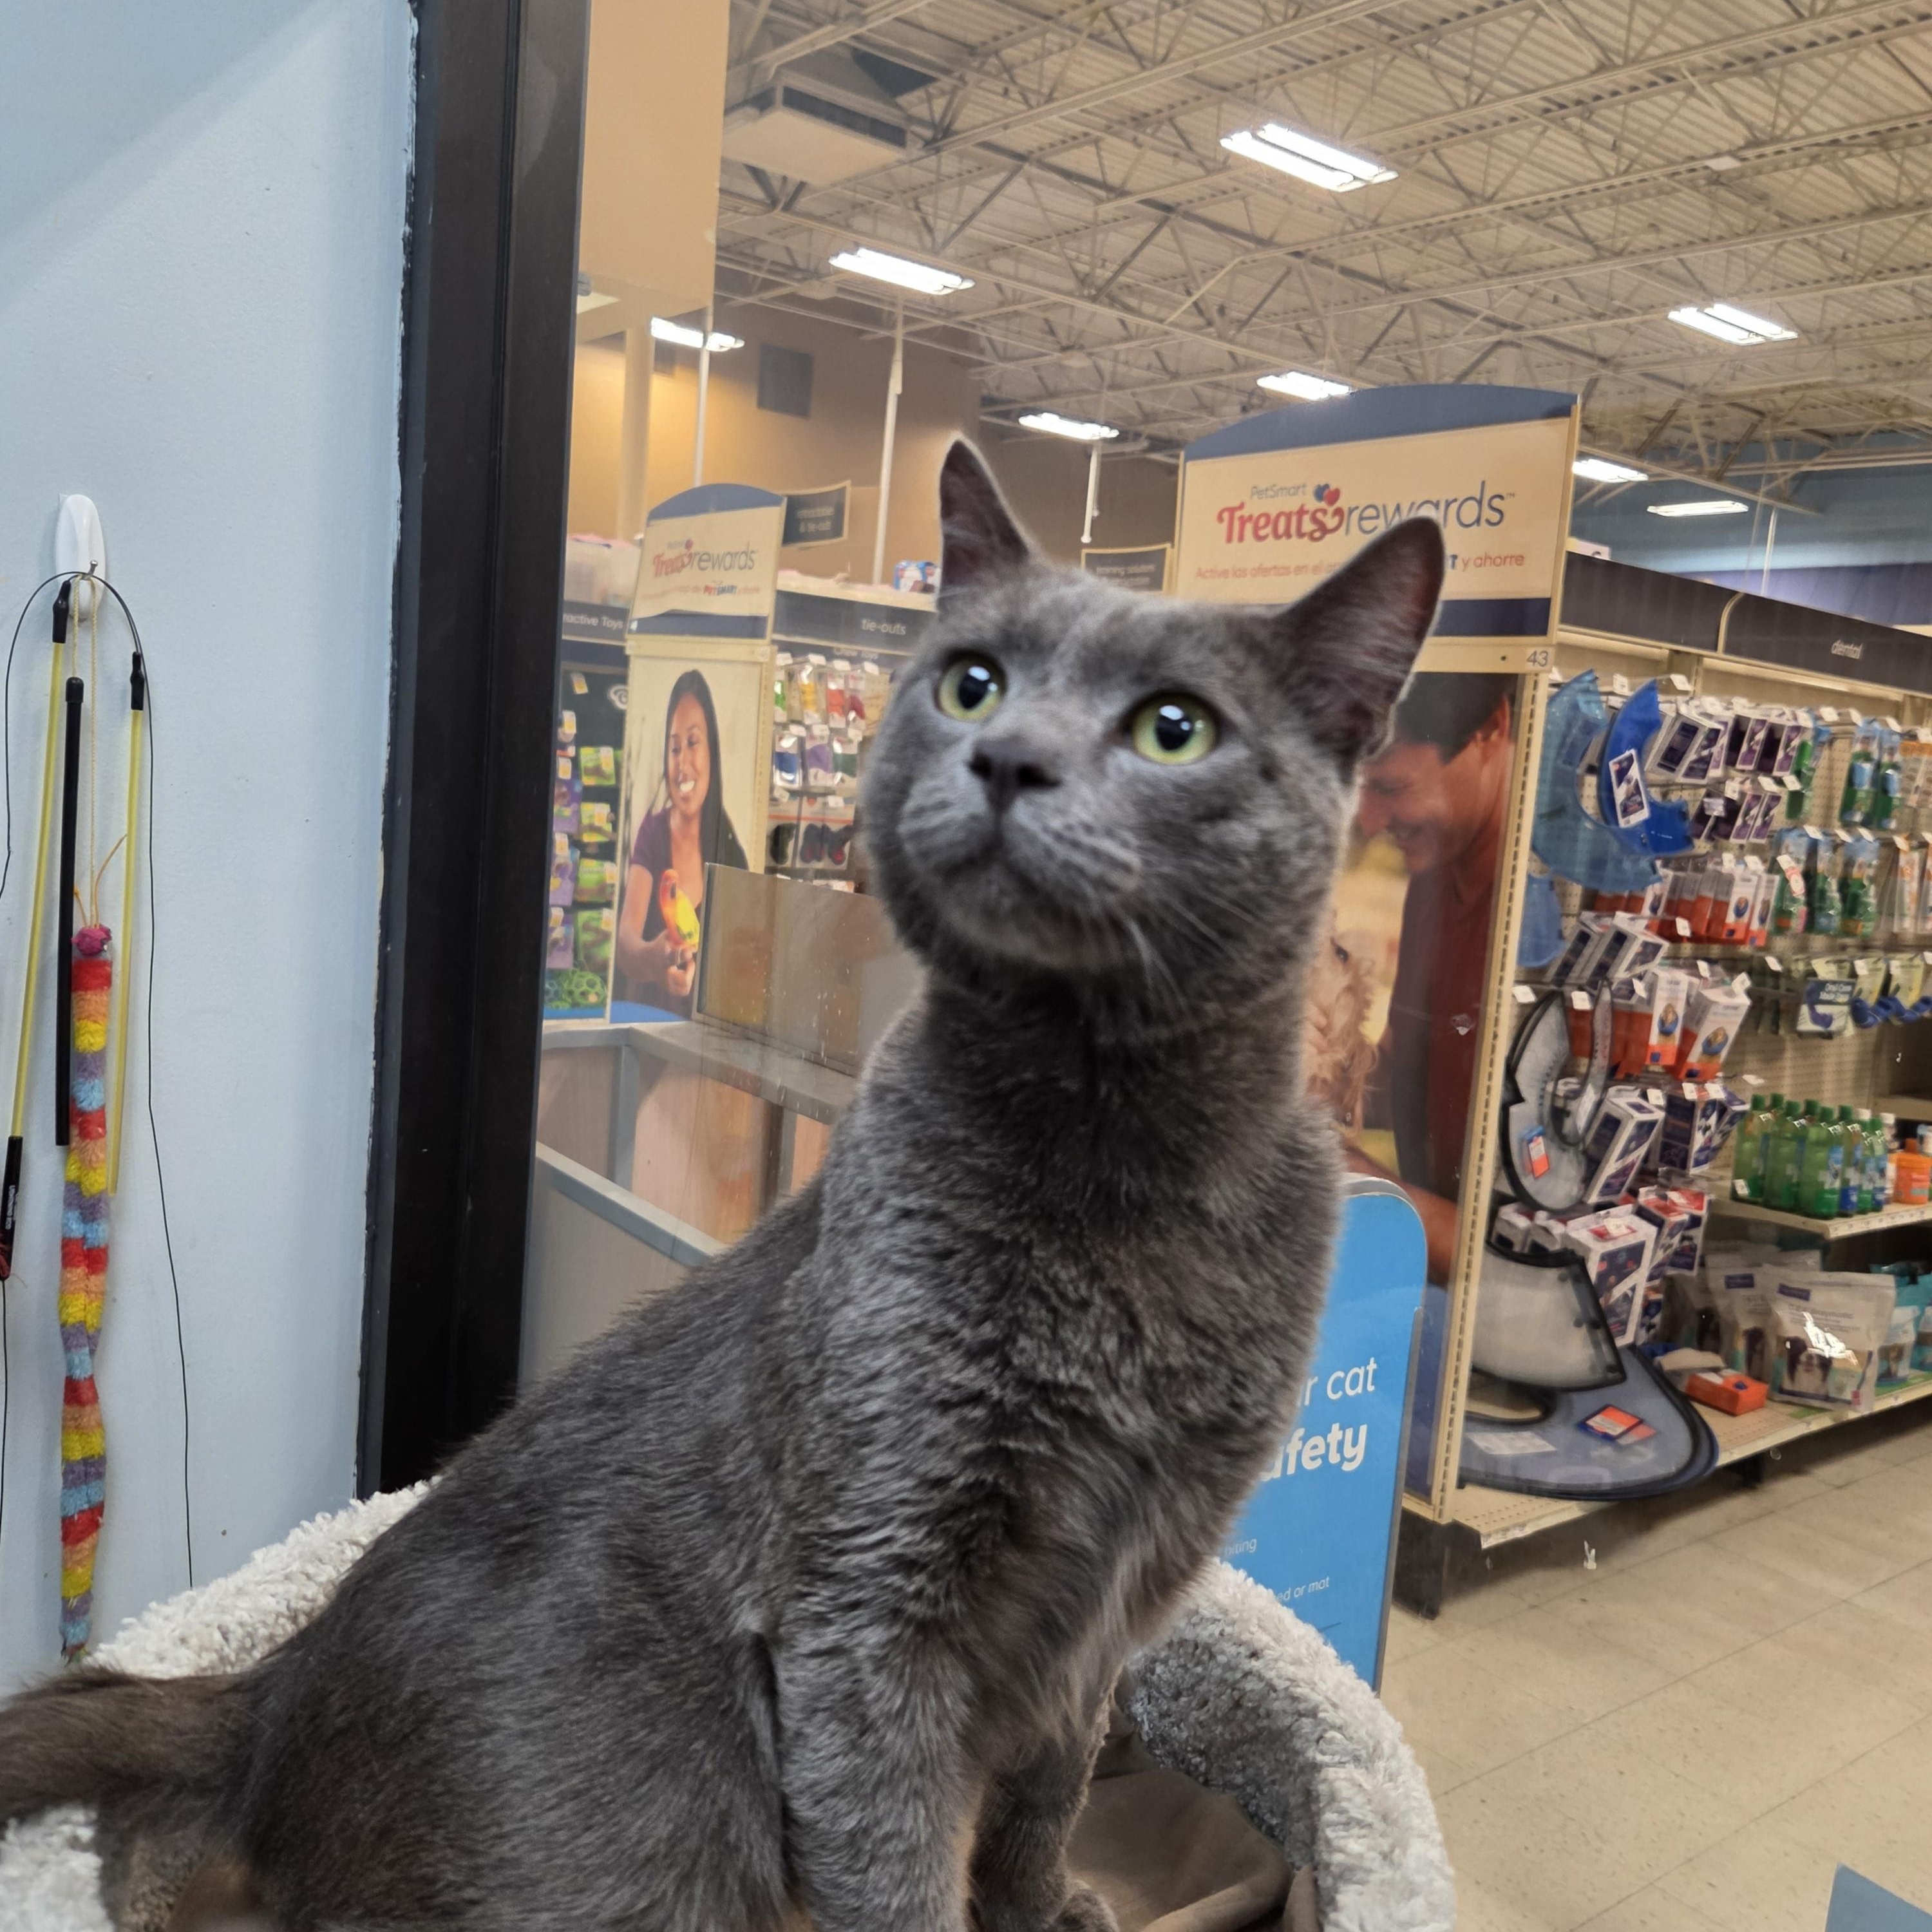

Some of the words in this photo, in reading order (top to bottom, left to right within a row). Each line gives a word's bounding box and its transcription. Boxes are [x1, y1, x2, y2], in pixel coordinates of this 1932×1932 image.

[1251, 484, 1307, 500] PetSmart
[1217, 501, 1345, 544] Treats
[691, 540, 756, 571] rewards
[1461, 558, 1472, 573] y
[1472, 552, 1525, 569] ahorre
[563, 614, 599, 627] ractive
[601, 615, 624, 632] Toys
[862, 618, 907, 636] tie-outs
[1526, 650, 1548, 667] 43
[1327, 1357, 1378, 1400] cat
[1260, 1422, 1368, 1482] fety
[1276, 1586, 1291, 1602] ed
[1293, 1585, 1307, 1598] or
[1308, 1575, 1330, 1593] mat
